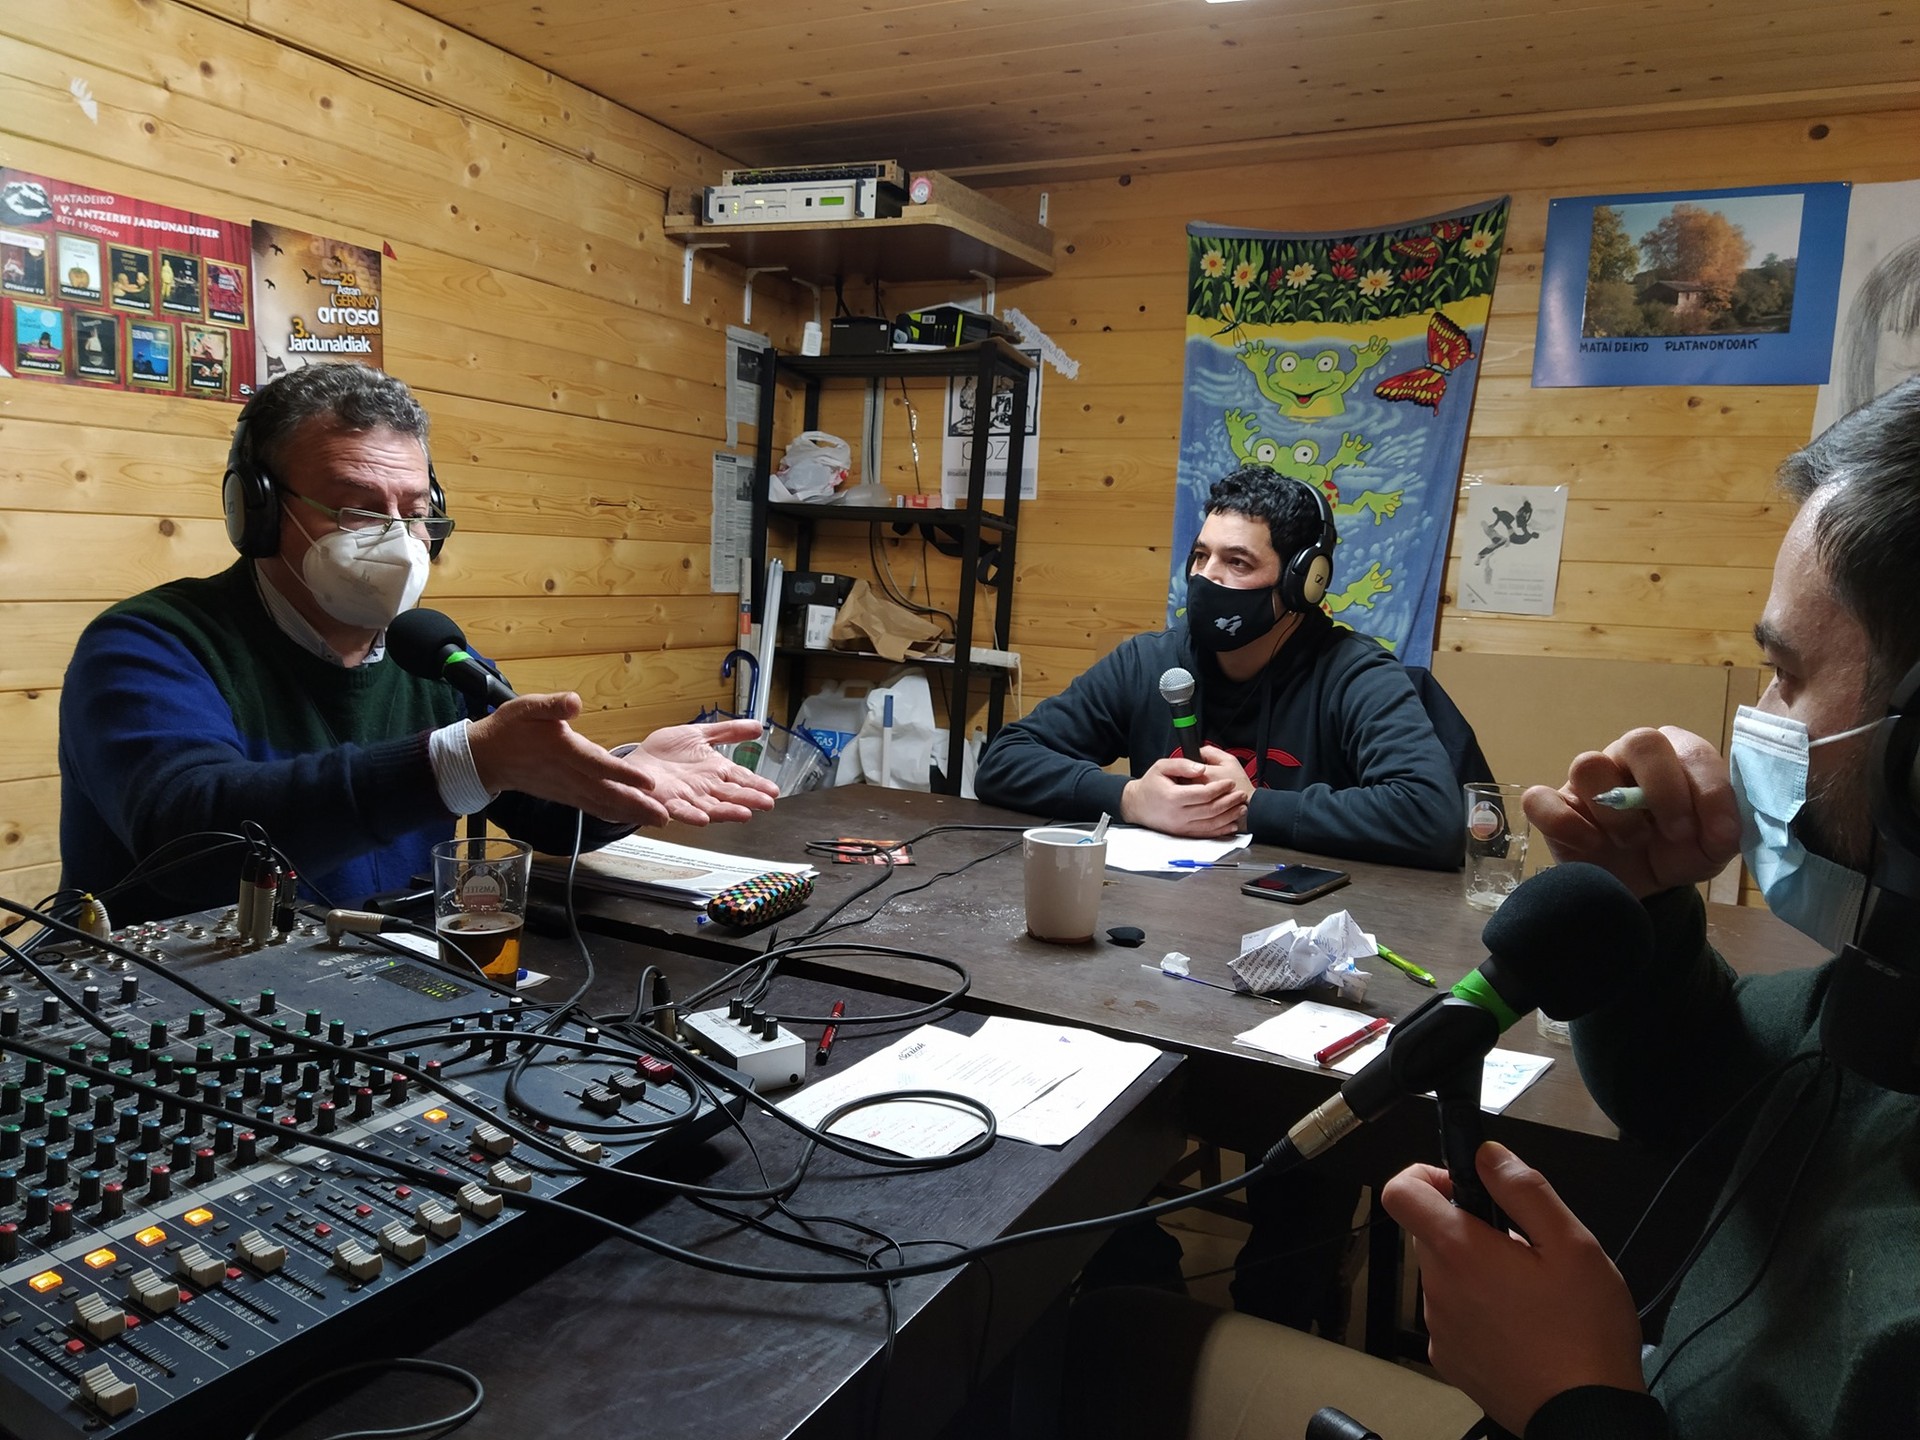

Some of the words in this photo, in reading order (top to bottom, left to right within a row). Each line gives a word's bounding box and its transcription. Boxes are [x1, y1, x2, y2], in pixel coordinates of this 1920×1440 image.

[53, 193, 115, 206] MATADEIKO
[55, 214, 75, 227] BETI
[60, 205, 73, 217] V.
[74, 208, 132, 225] ANTZERKI
[340, 272, 356, 287] 29
[317, 306, 379, 326] arrosa
[291, 317, 310, 338] 3.
[288, 334, 372, 353] Jardunaldiak
[246, 1349, 255, 1357] 3
[193, 1377, 203, 1385] 2
